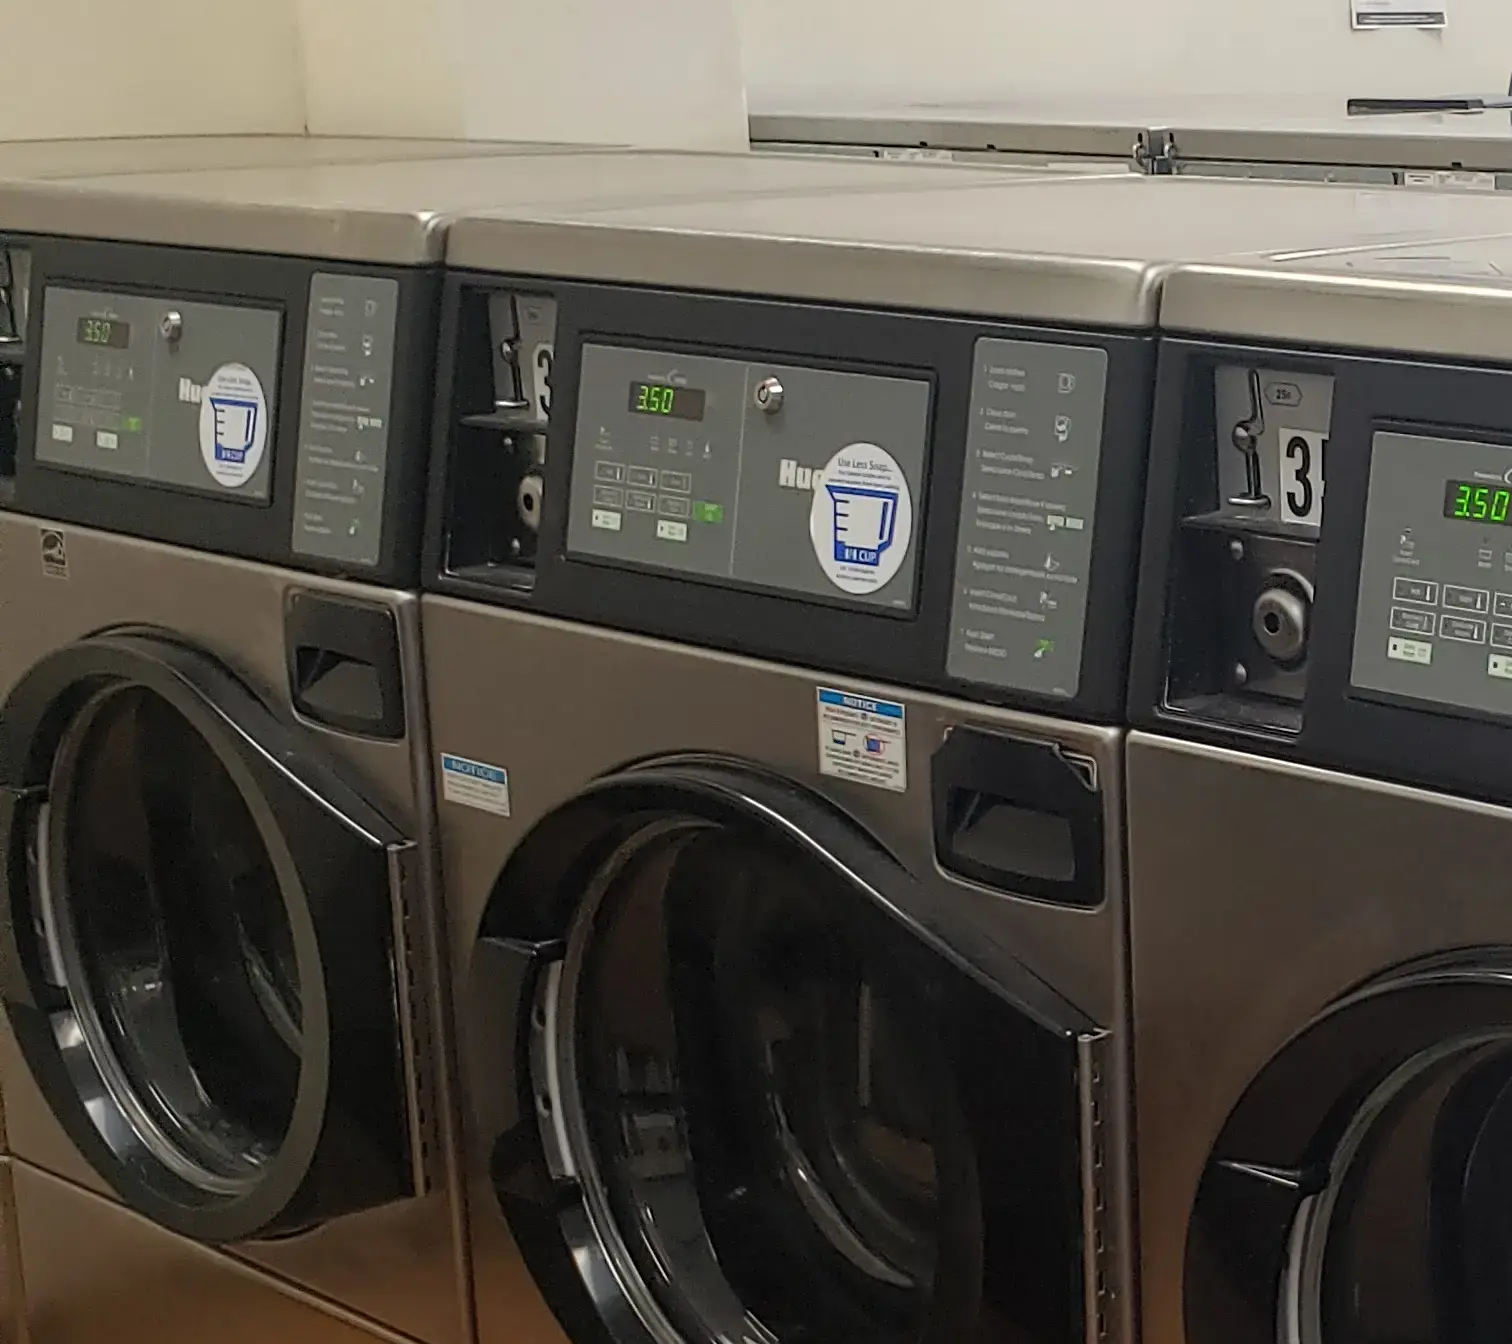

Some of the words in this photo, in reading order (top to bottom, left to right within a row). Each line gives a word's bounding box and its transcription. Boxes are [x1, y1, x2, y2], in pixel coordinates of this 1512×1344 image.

[1286, 436, 1312, 517] 3
[1454, 485, 1510, 522] 3.50
[843, 695, 877, 712] NOTICE
